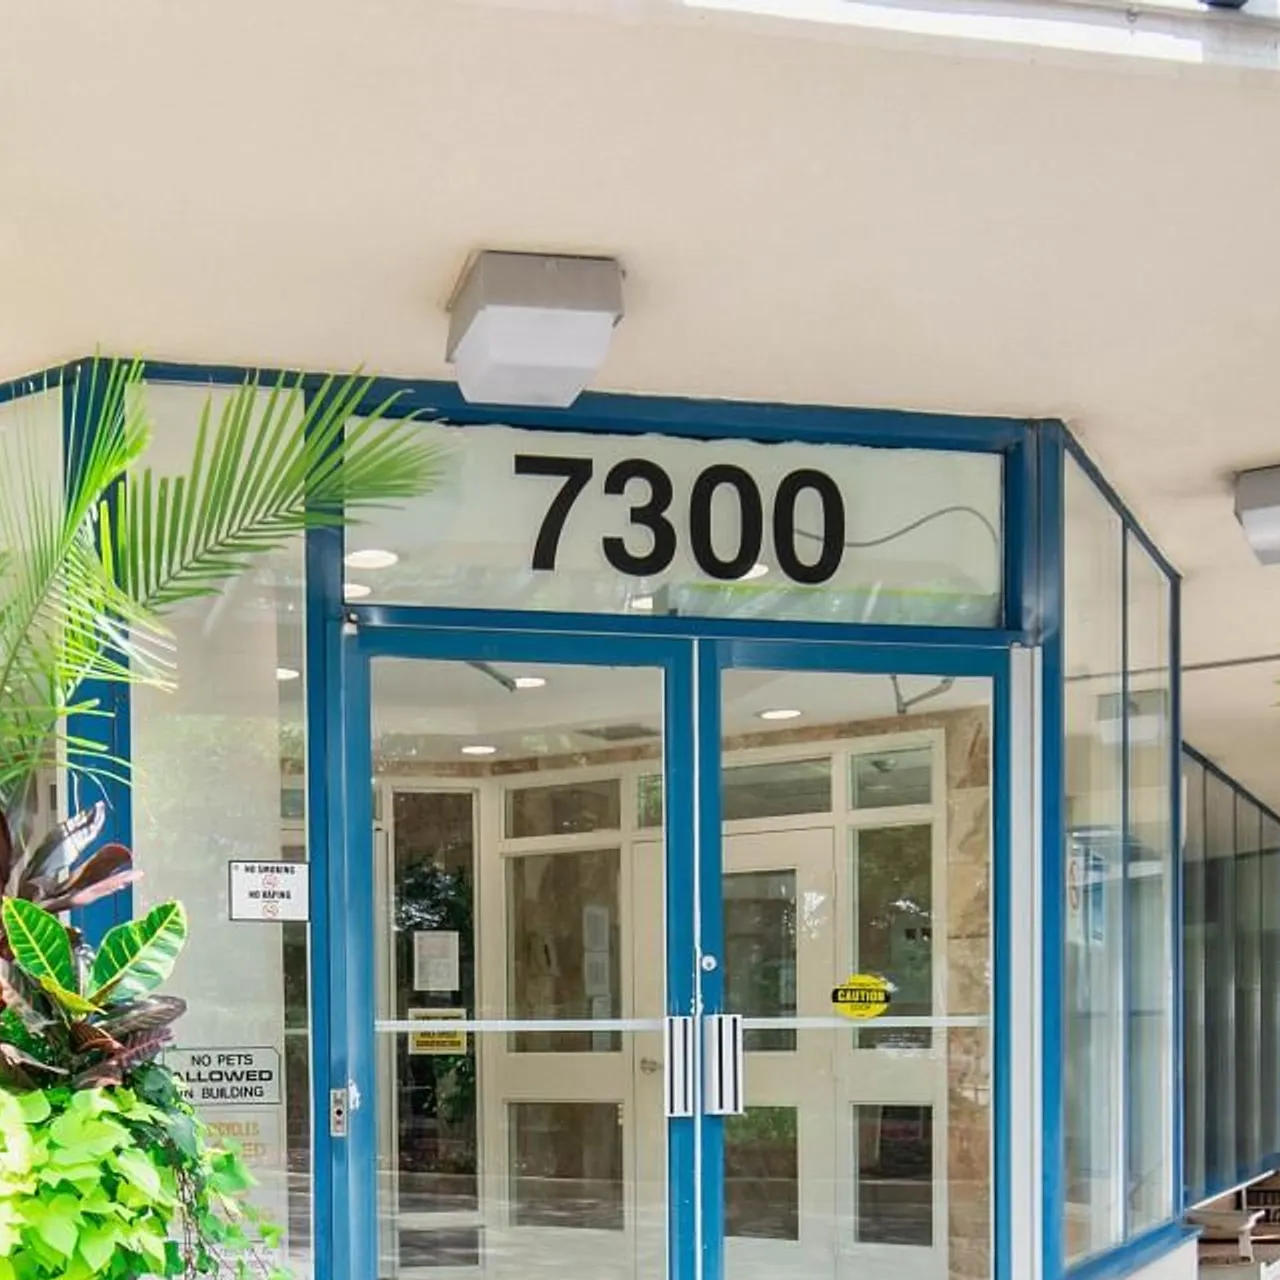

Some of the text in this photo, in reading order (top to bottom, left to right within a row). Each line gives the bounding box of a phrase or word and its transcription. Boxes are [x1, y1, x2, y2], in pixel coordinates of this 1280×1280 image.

[513, 454, 846, 585] 7300
[244, 864, 256, 874] NO
[837, 989, 886, 1002] CAUTION
[191, 1053, 254, 1067] NO PETS
[201, 1085, 265, 1100] BUILDING
